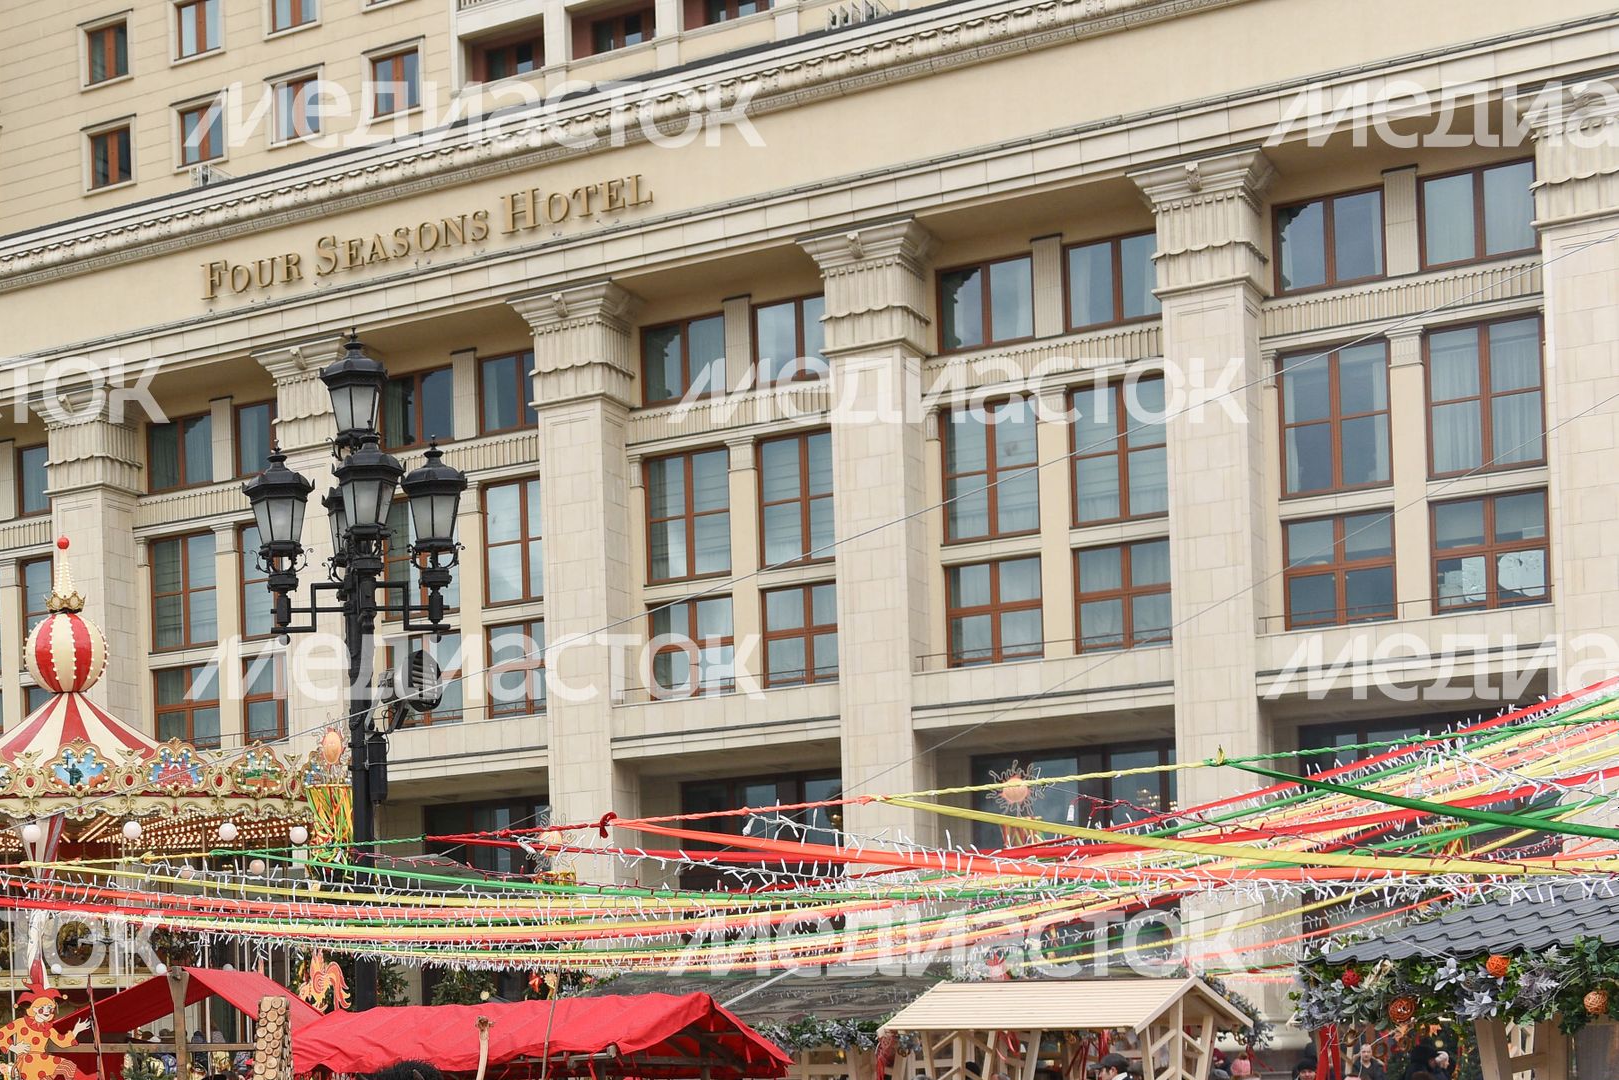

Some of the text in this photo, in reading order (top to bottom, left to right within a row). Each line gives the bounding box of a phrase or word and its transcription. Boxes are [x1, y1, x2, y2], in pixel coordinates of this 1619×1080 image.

[201, 174, 653, 300] FOUR SEASONS HOTEL
